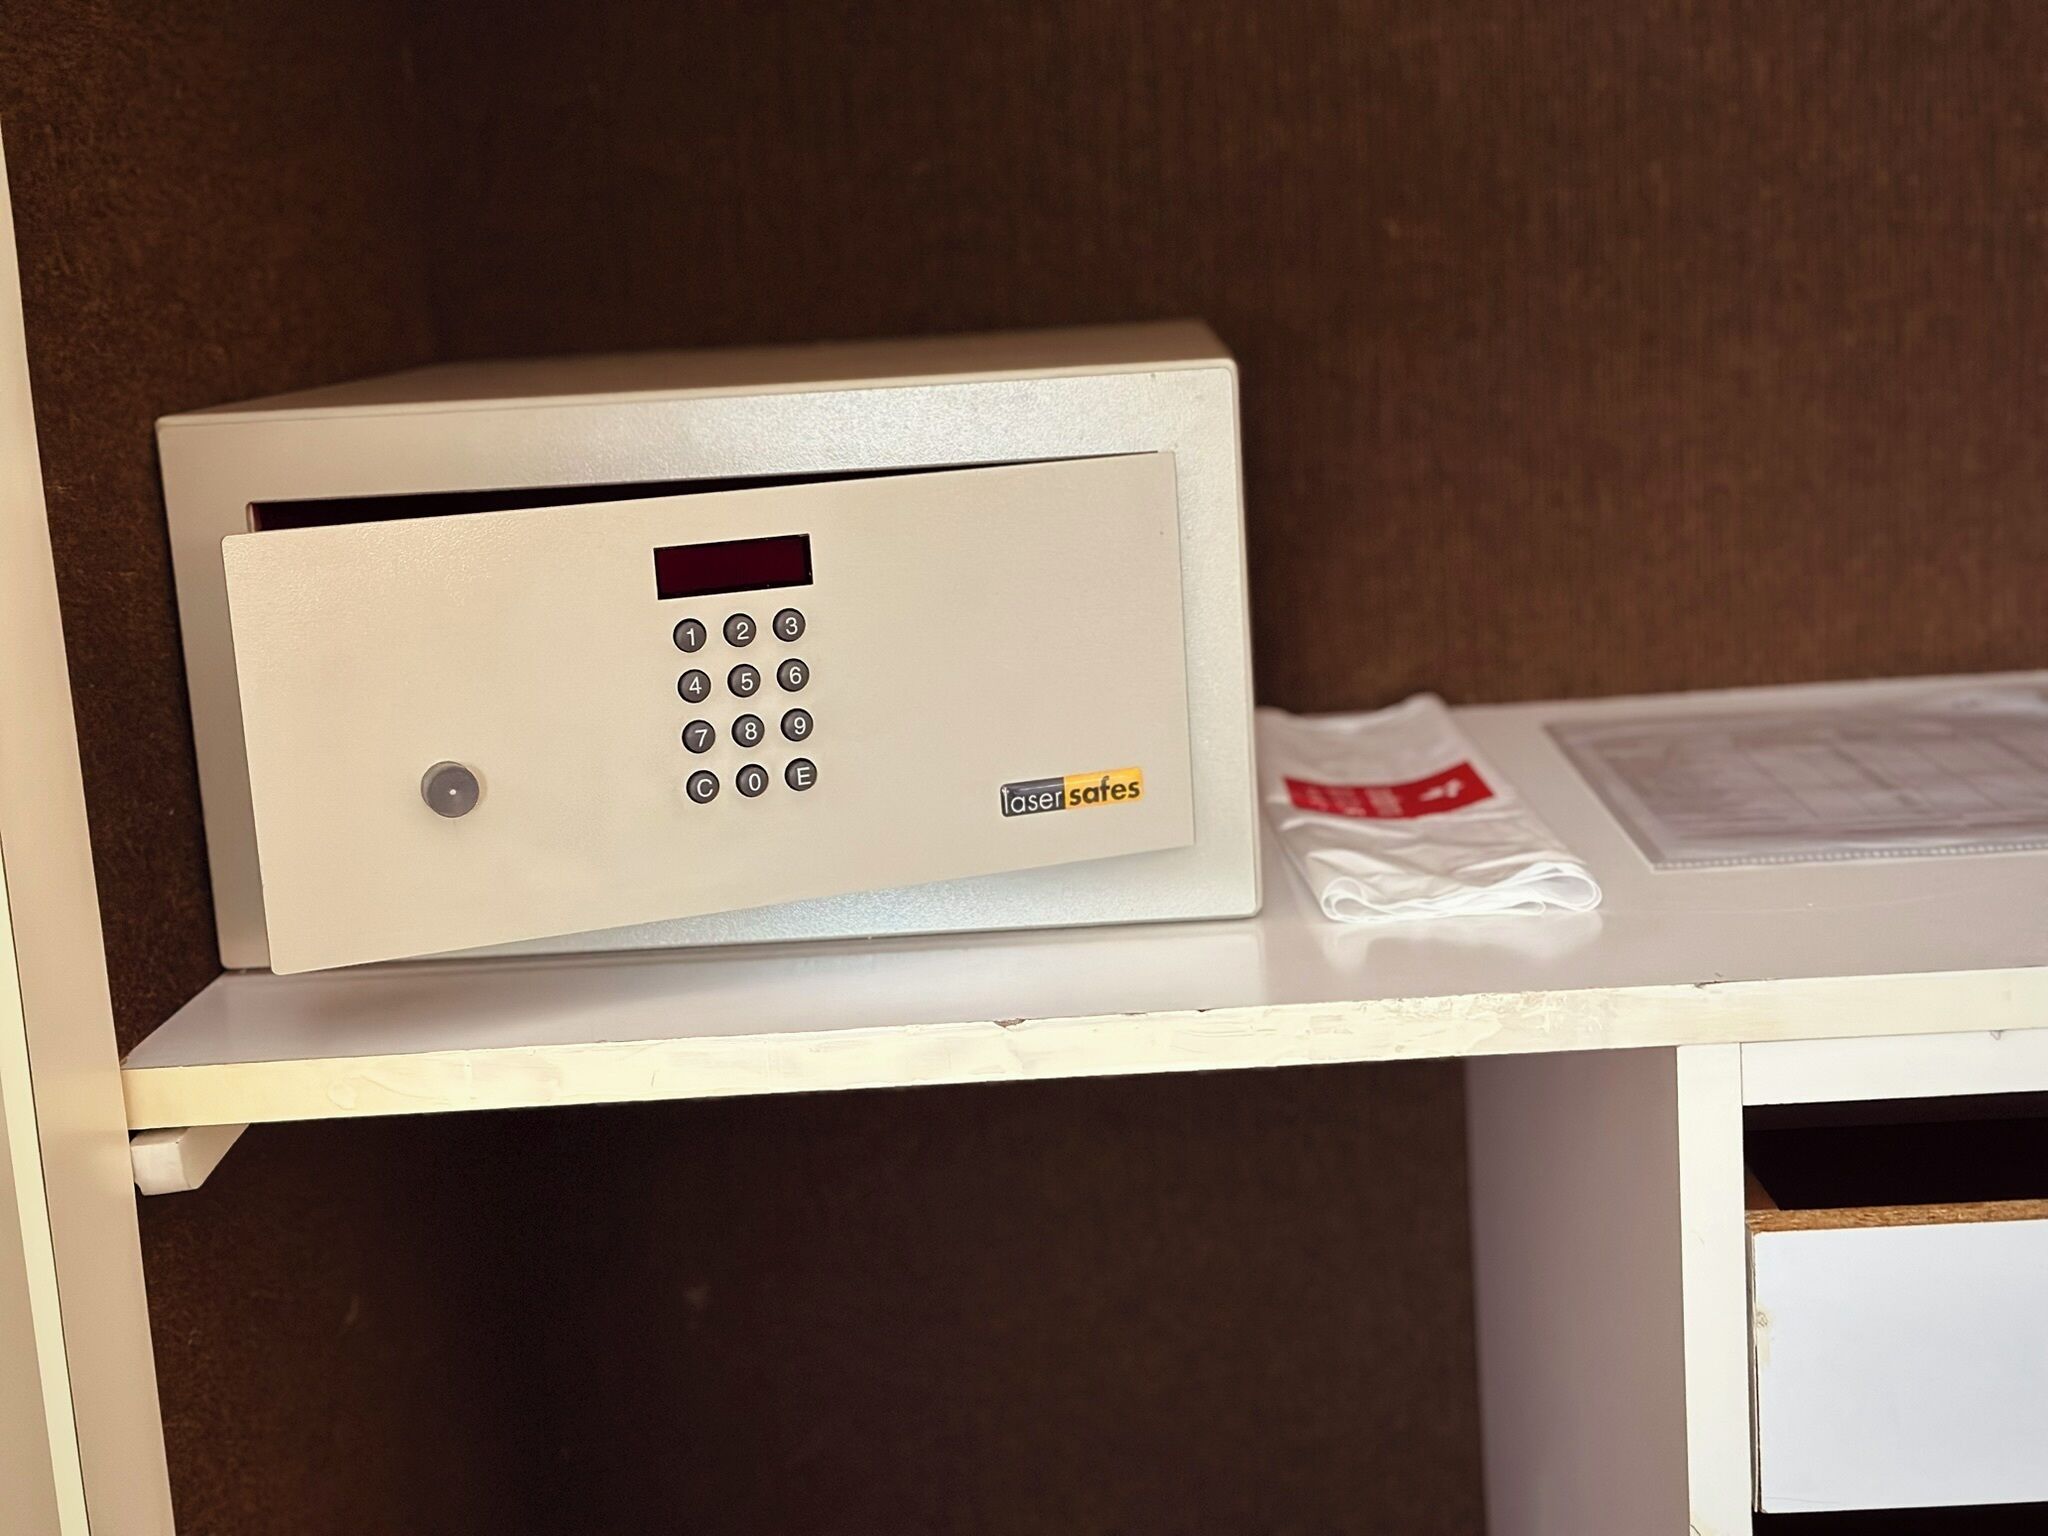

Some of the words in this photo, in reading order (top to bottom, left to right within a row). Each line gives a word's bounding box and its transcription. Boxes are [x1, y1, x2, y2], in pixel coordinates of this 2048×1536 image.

[686, 628, 695, 646] 1
[736, 622, 750, 640] 2
[785, 617, 798, 635] 3
[689, 677, 702, 694] 4
[741, 673, 753, 691] 5
[789, 666, 801, 685] 6
[694, 729, 708, 747] 7
[745, 722, 757, 740] 8
[794, 717, 806, 735] 9
[696, 778, 713, 797] C
[796, 767, 811, 786] E
[1001, 786, 1063, 814] laser
[1069, 775, 1140, 806] safes
